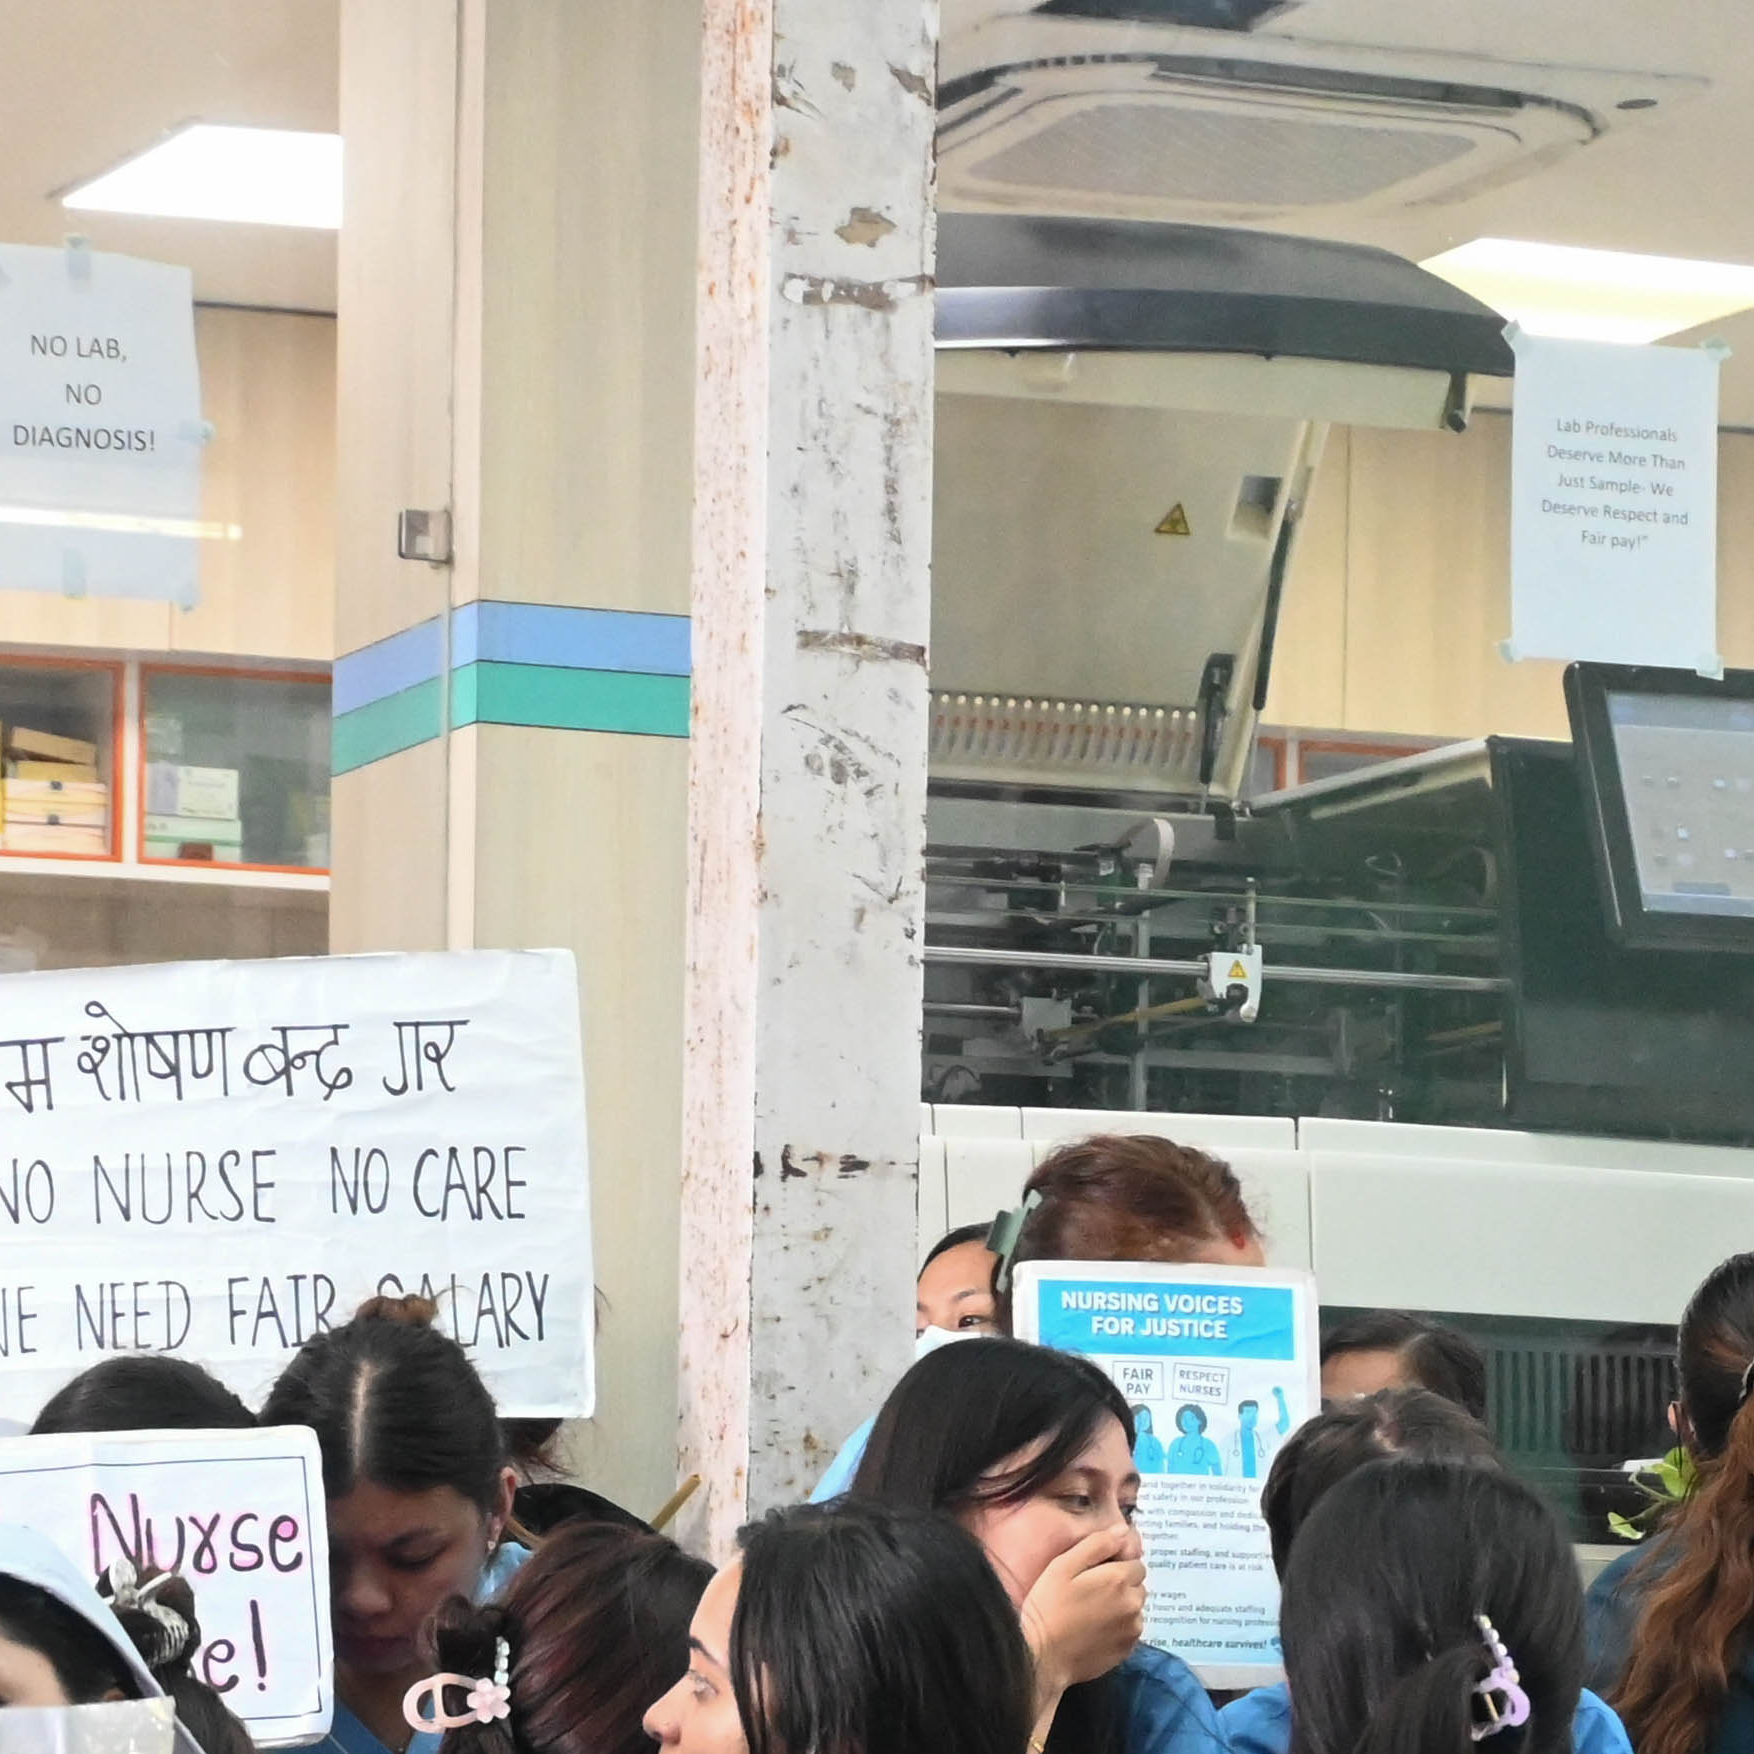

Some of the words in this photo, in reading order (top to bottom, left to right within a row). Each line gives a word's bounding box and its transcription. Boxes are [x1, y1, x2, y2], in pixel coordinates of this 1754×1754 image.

[30, 334, 68, 357] NO
[76, 336, 127, 362] LAB,
[65, 383, 102, 406] NO
[13, 424, 155, 451] DIAGNOSIS!
[1557, 418, 1581, 433] Lab
[1586, 420, 1678, 443] Professionals
[1547, 444, 1603, 463] Deserve
[1608, 450, 1646, 466] More
[1651, 453, 1685, 470] Than
[1557, 474, 1584, 489] Just
[1650, 482, 1674, 496] We
[1541, 499, 1598, 518] Deserve
[1603, 504, 1658, 522] Respect
[1662, 511, 1689, 525] and
[1581, 530, 1606, 545] Fair
[76, 1000, 238, 1102] शोषण
[243, 1023, 355, 1102] बन्द
[382, 1019, 471, 1096] गर
[93, 1148, 278, 1226] NURSE
[330, 1145, 390, 1216] NO
[413, 1145, 528, 1222] CARE
[75, 1279, 192, 1352] NEED
[228, 1273, 338, 1350] FAIR
[1061, 1290, 1159, 1313] NURSING
[1164, 1293, 1243, 1316] VOICES
[1091, 1315, 1135, 1336] FOR
[1140, 1317, 1228, 1339] JUSTICE
[1123, 1367, 1154, 1381] FAIR
[1178, 1369, 1226, 1383] RESPECT
[1126, 1383, 1151, 1396] PAY
[1179, 1384, 1222, 1397] NURSES
[88, 1491, 306, 1580] Nurse
[1178, 1604, 1193, 1612] and
[1172, 1639, 1223, 1650] healthcare
[1225, 1640, 1267, 1650] survives!
